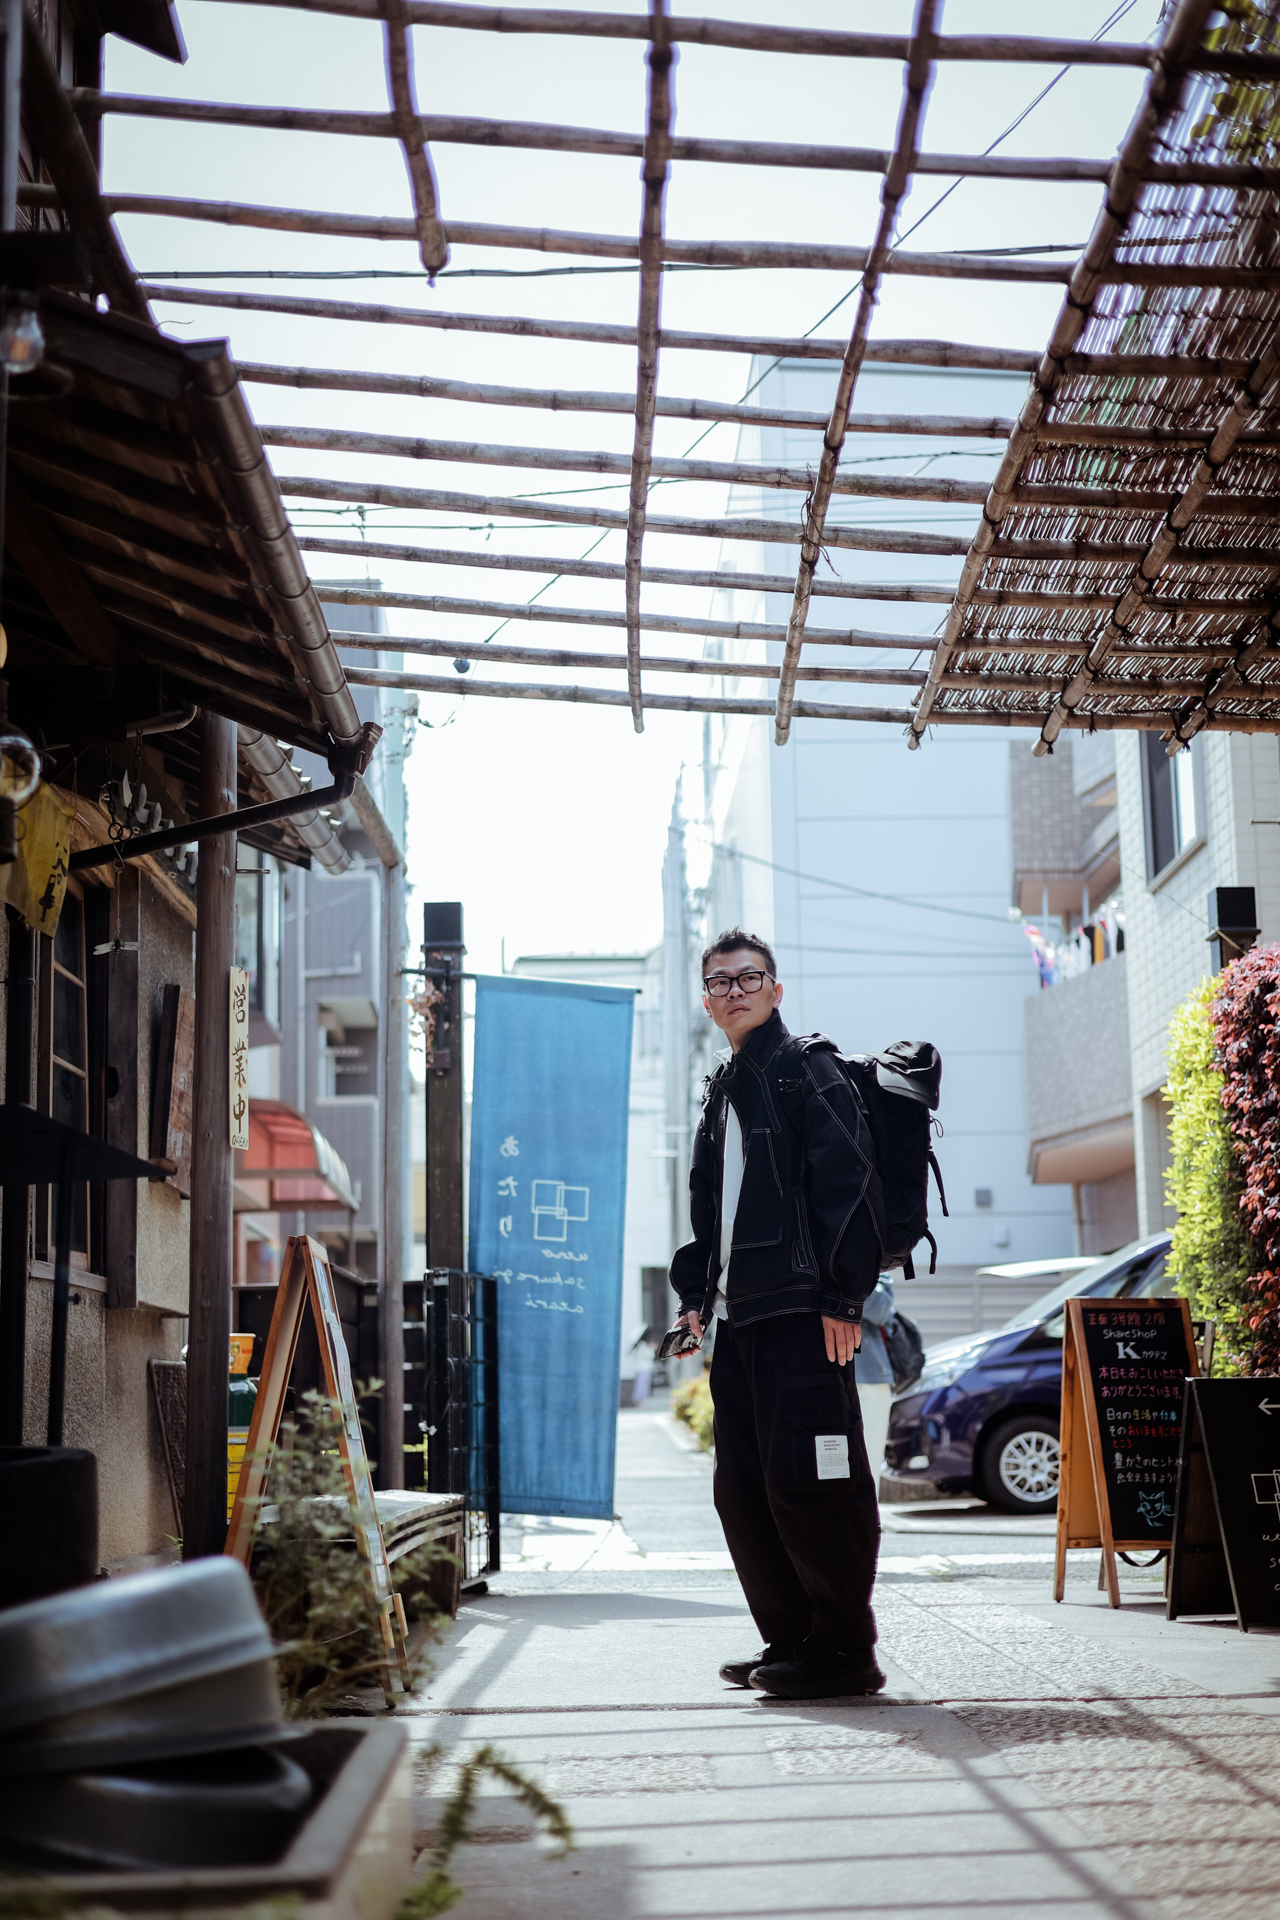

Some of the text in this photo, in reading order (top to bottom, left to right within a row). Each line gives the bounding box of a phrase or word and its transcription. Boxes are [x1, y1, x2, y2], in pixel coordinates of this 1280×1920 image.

[231, 983, 247, 1134] 営業中
[231, 1134, 249, 1148] OPEN
[1115, 1341, 1142, 1359] K
